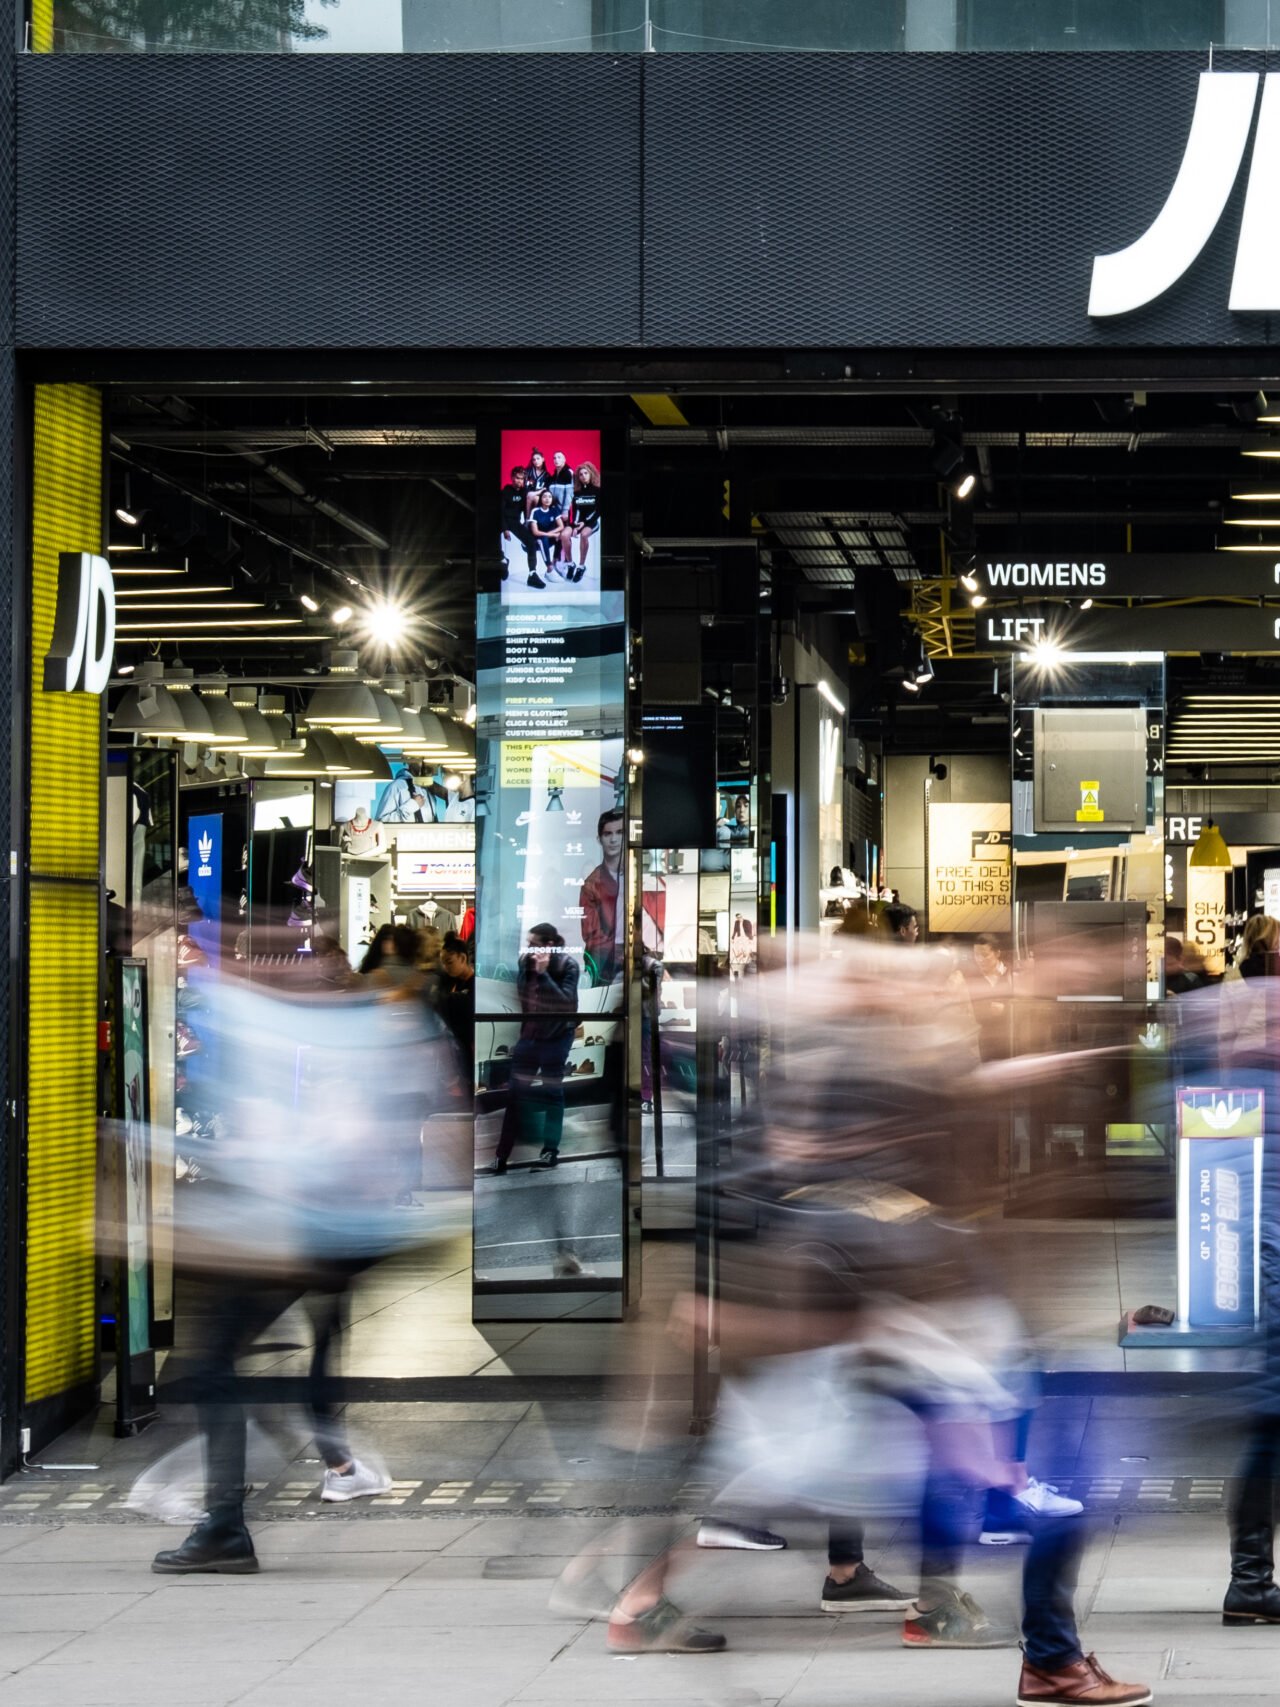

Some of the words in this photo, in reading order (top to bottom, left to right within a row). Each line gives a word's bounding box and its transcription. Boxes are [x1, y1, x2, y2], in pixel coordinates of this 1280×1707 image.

[987, 563, 1106, 586] WOMENS
[65, 552, 116, 694] JD
[987, 618, 1045, 641] LIFT
[983, 832, 1001, 844] JD
[1165, 817, 1202, 840] RE
[936, 866, 974, 878] FREE
[979, 866, 1011, 878] DELI
[936, 880, 956, 892] TO
[962, 880, 994, 892] THIS
[936, 895, 1011, 906] JDSPORTS.
[519, 946, 585, 955] JDSPORTS.COM
[1200, 1170, 1211, 1206] ONLY
[1200, 1212, 1211, 1232] AT
[1200, 1241, 1211, 1260] JD
